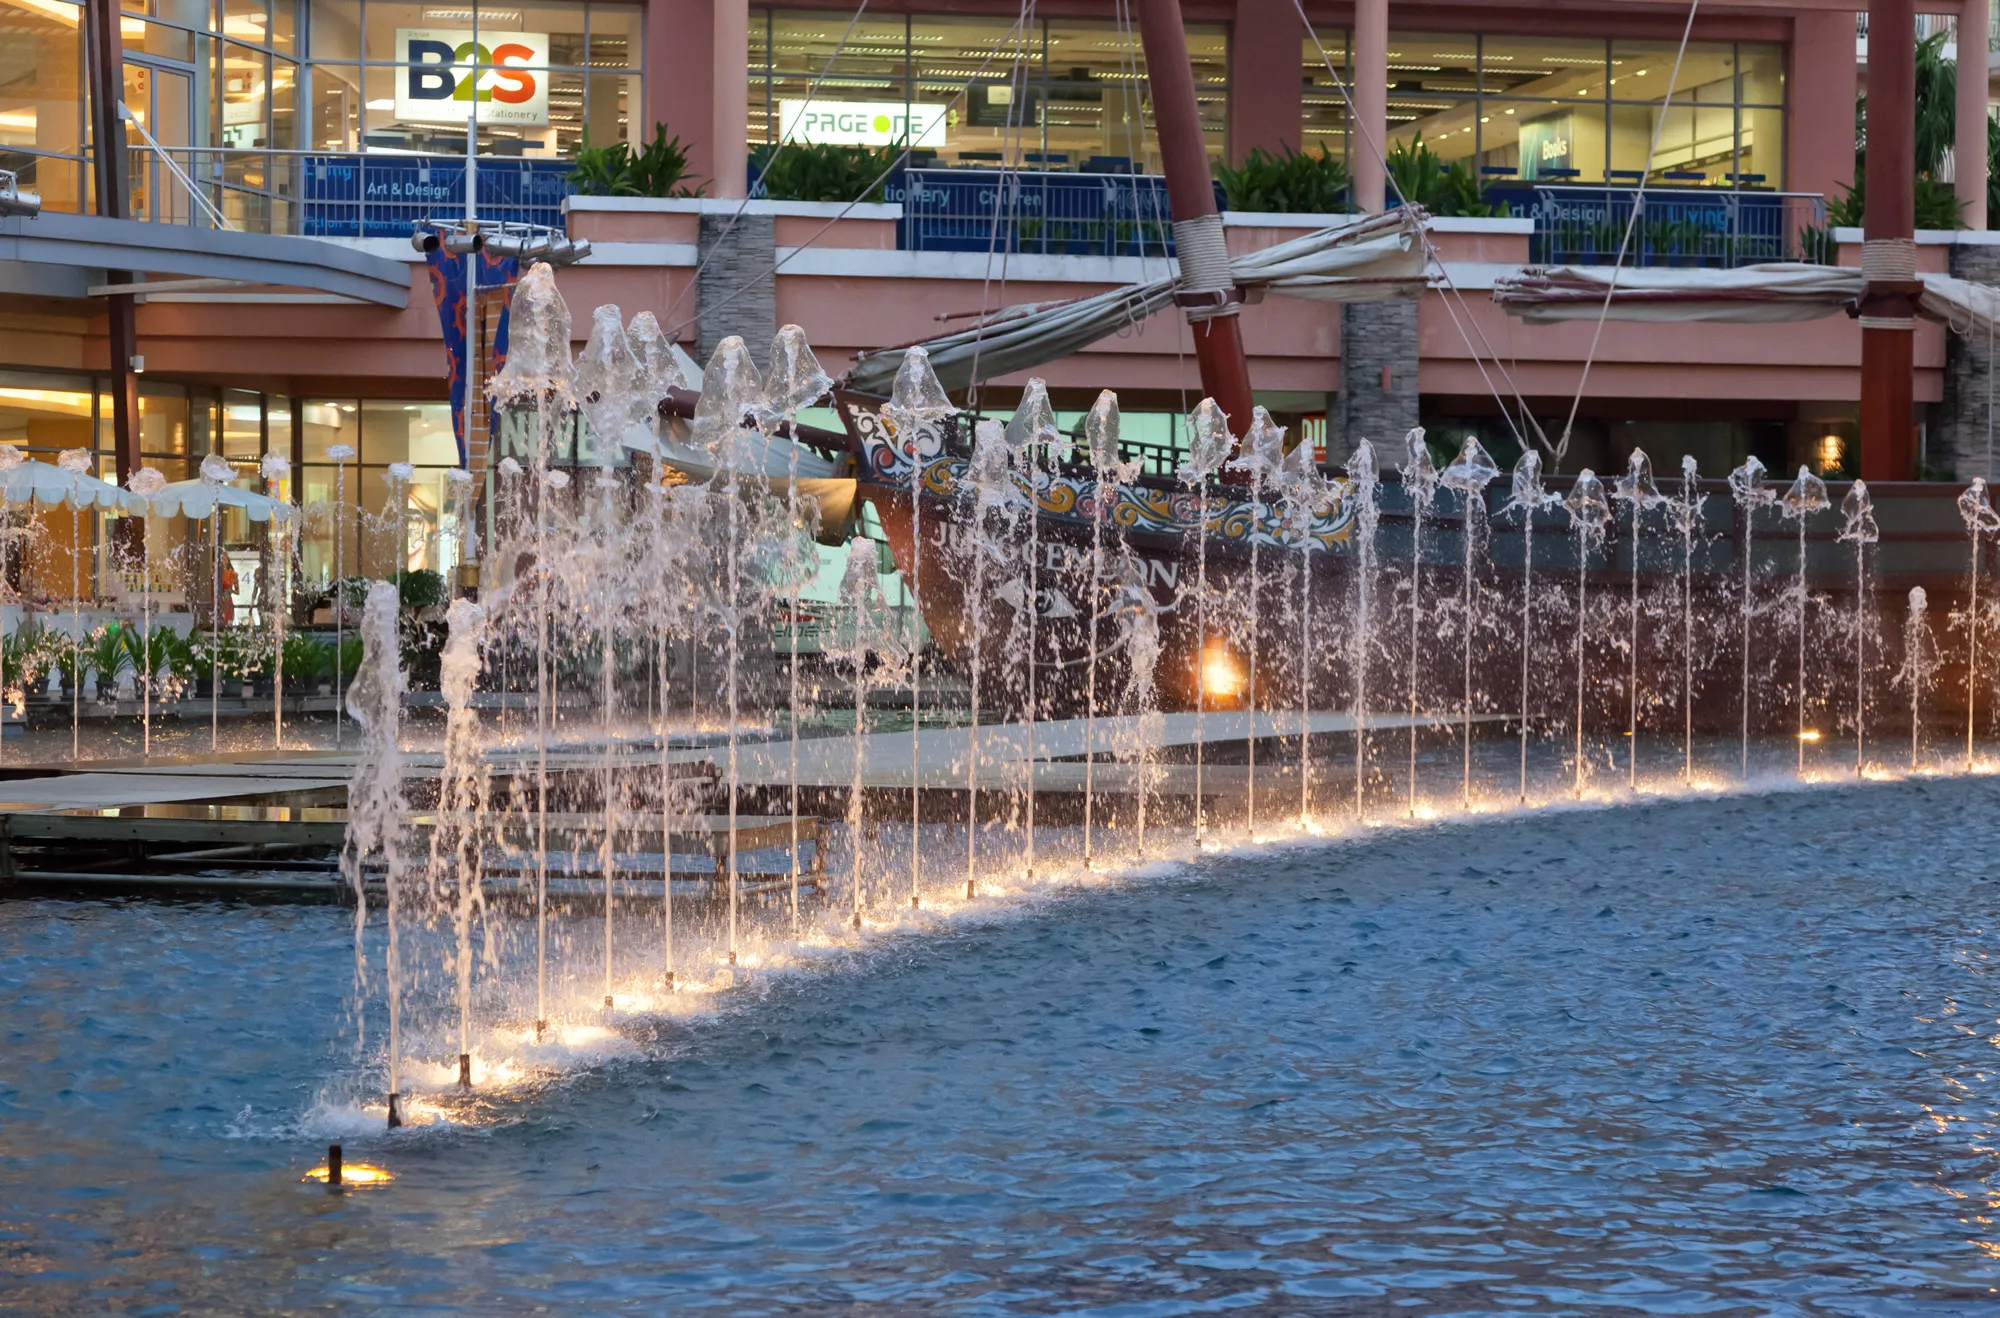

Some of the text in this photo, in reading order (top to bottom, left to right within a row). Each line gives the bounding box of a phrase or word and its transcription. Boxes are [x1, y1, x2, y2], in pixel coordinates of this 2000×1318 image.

[409, 40, 536, 104] B2S
[805, 113, 868, 133] PAGE
[1543, 138, 1567, 160] Books
[367, 182, 450, 199] Art & Design
[979, 190, 1042, 206] Chlren
[1551, 204, 1607, 225] Design
[1669, 204, 1729, 232] Lving
